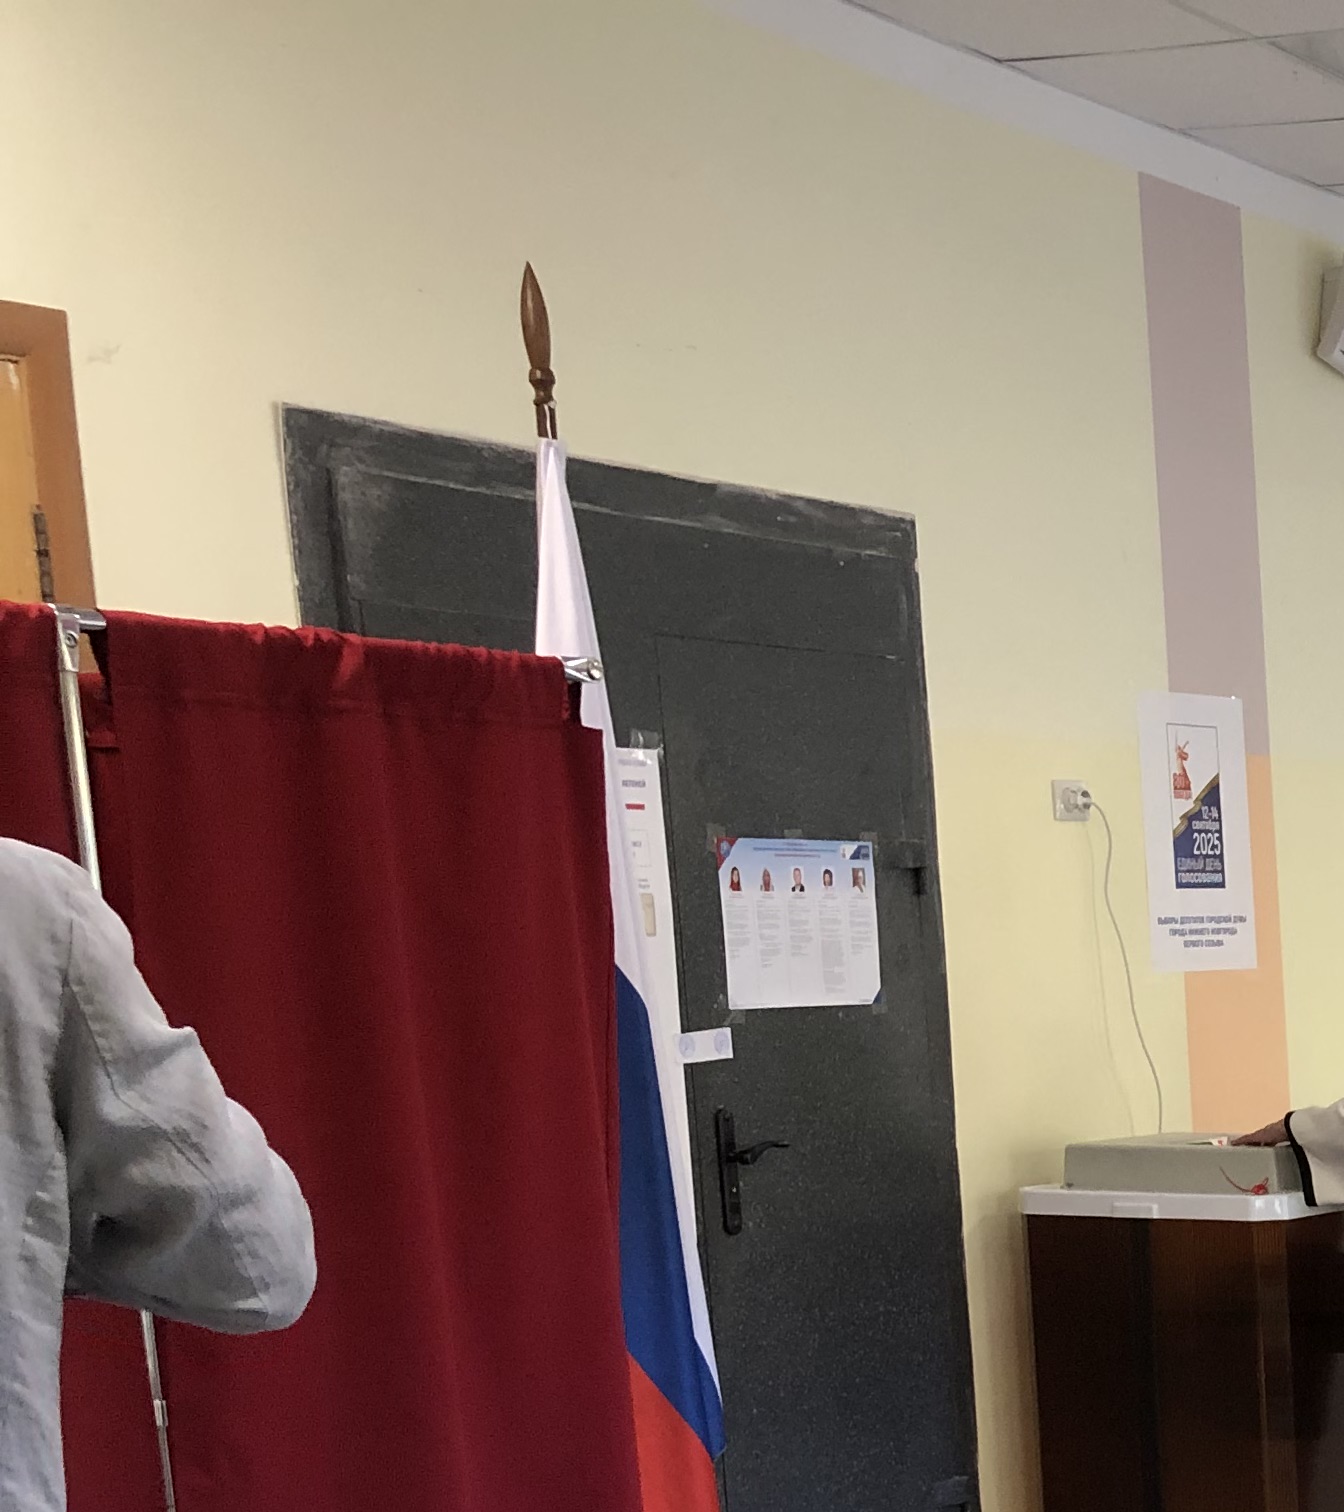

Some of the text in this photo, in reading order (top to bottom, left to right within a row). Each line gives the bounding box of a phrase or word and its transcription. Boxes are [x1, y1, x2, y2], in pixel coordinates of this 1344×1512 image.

[1202, 806, 1219, 819] 12-14
[1193, 833, 1221, 855] 2025
[1177, 857, 1222, 871] ЕДИНЫЙ ДЕНЬ
